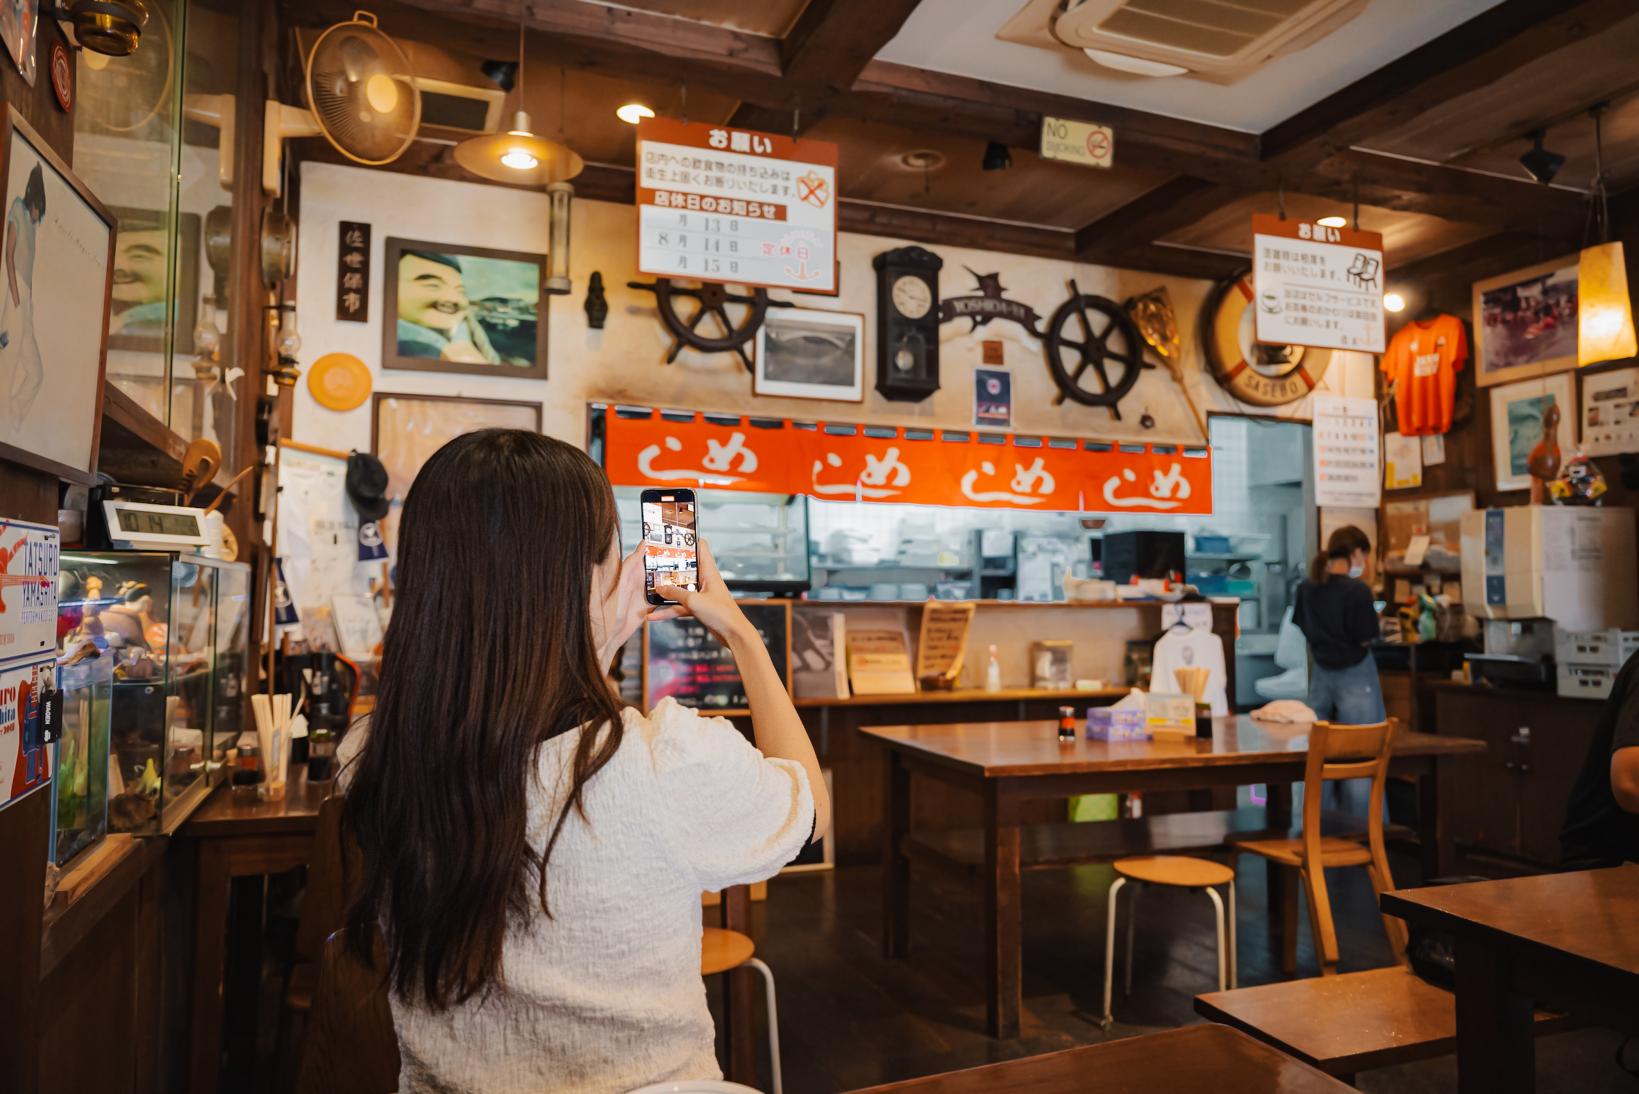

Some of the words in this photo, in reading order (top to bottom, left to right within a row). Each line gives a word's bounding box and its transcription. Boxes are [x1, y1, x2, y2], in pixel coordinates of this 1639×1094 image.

[708, 128, 773, 154] お願い
[1047, 122, 1069, 140] NO
[654, 190, 778, 219] 店休日のお知らせ
[1298, 222, 1341, 243] お願い
[342, 229, 365, 314] 佐世保市
[23, 541, 58, 577] TATSURO
